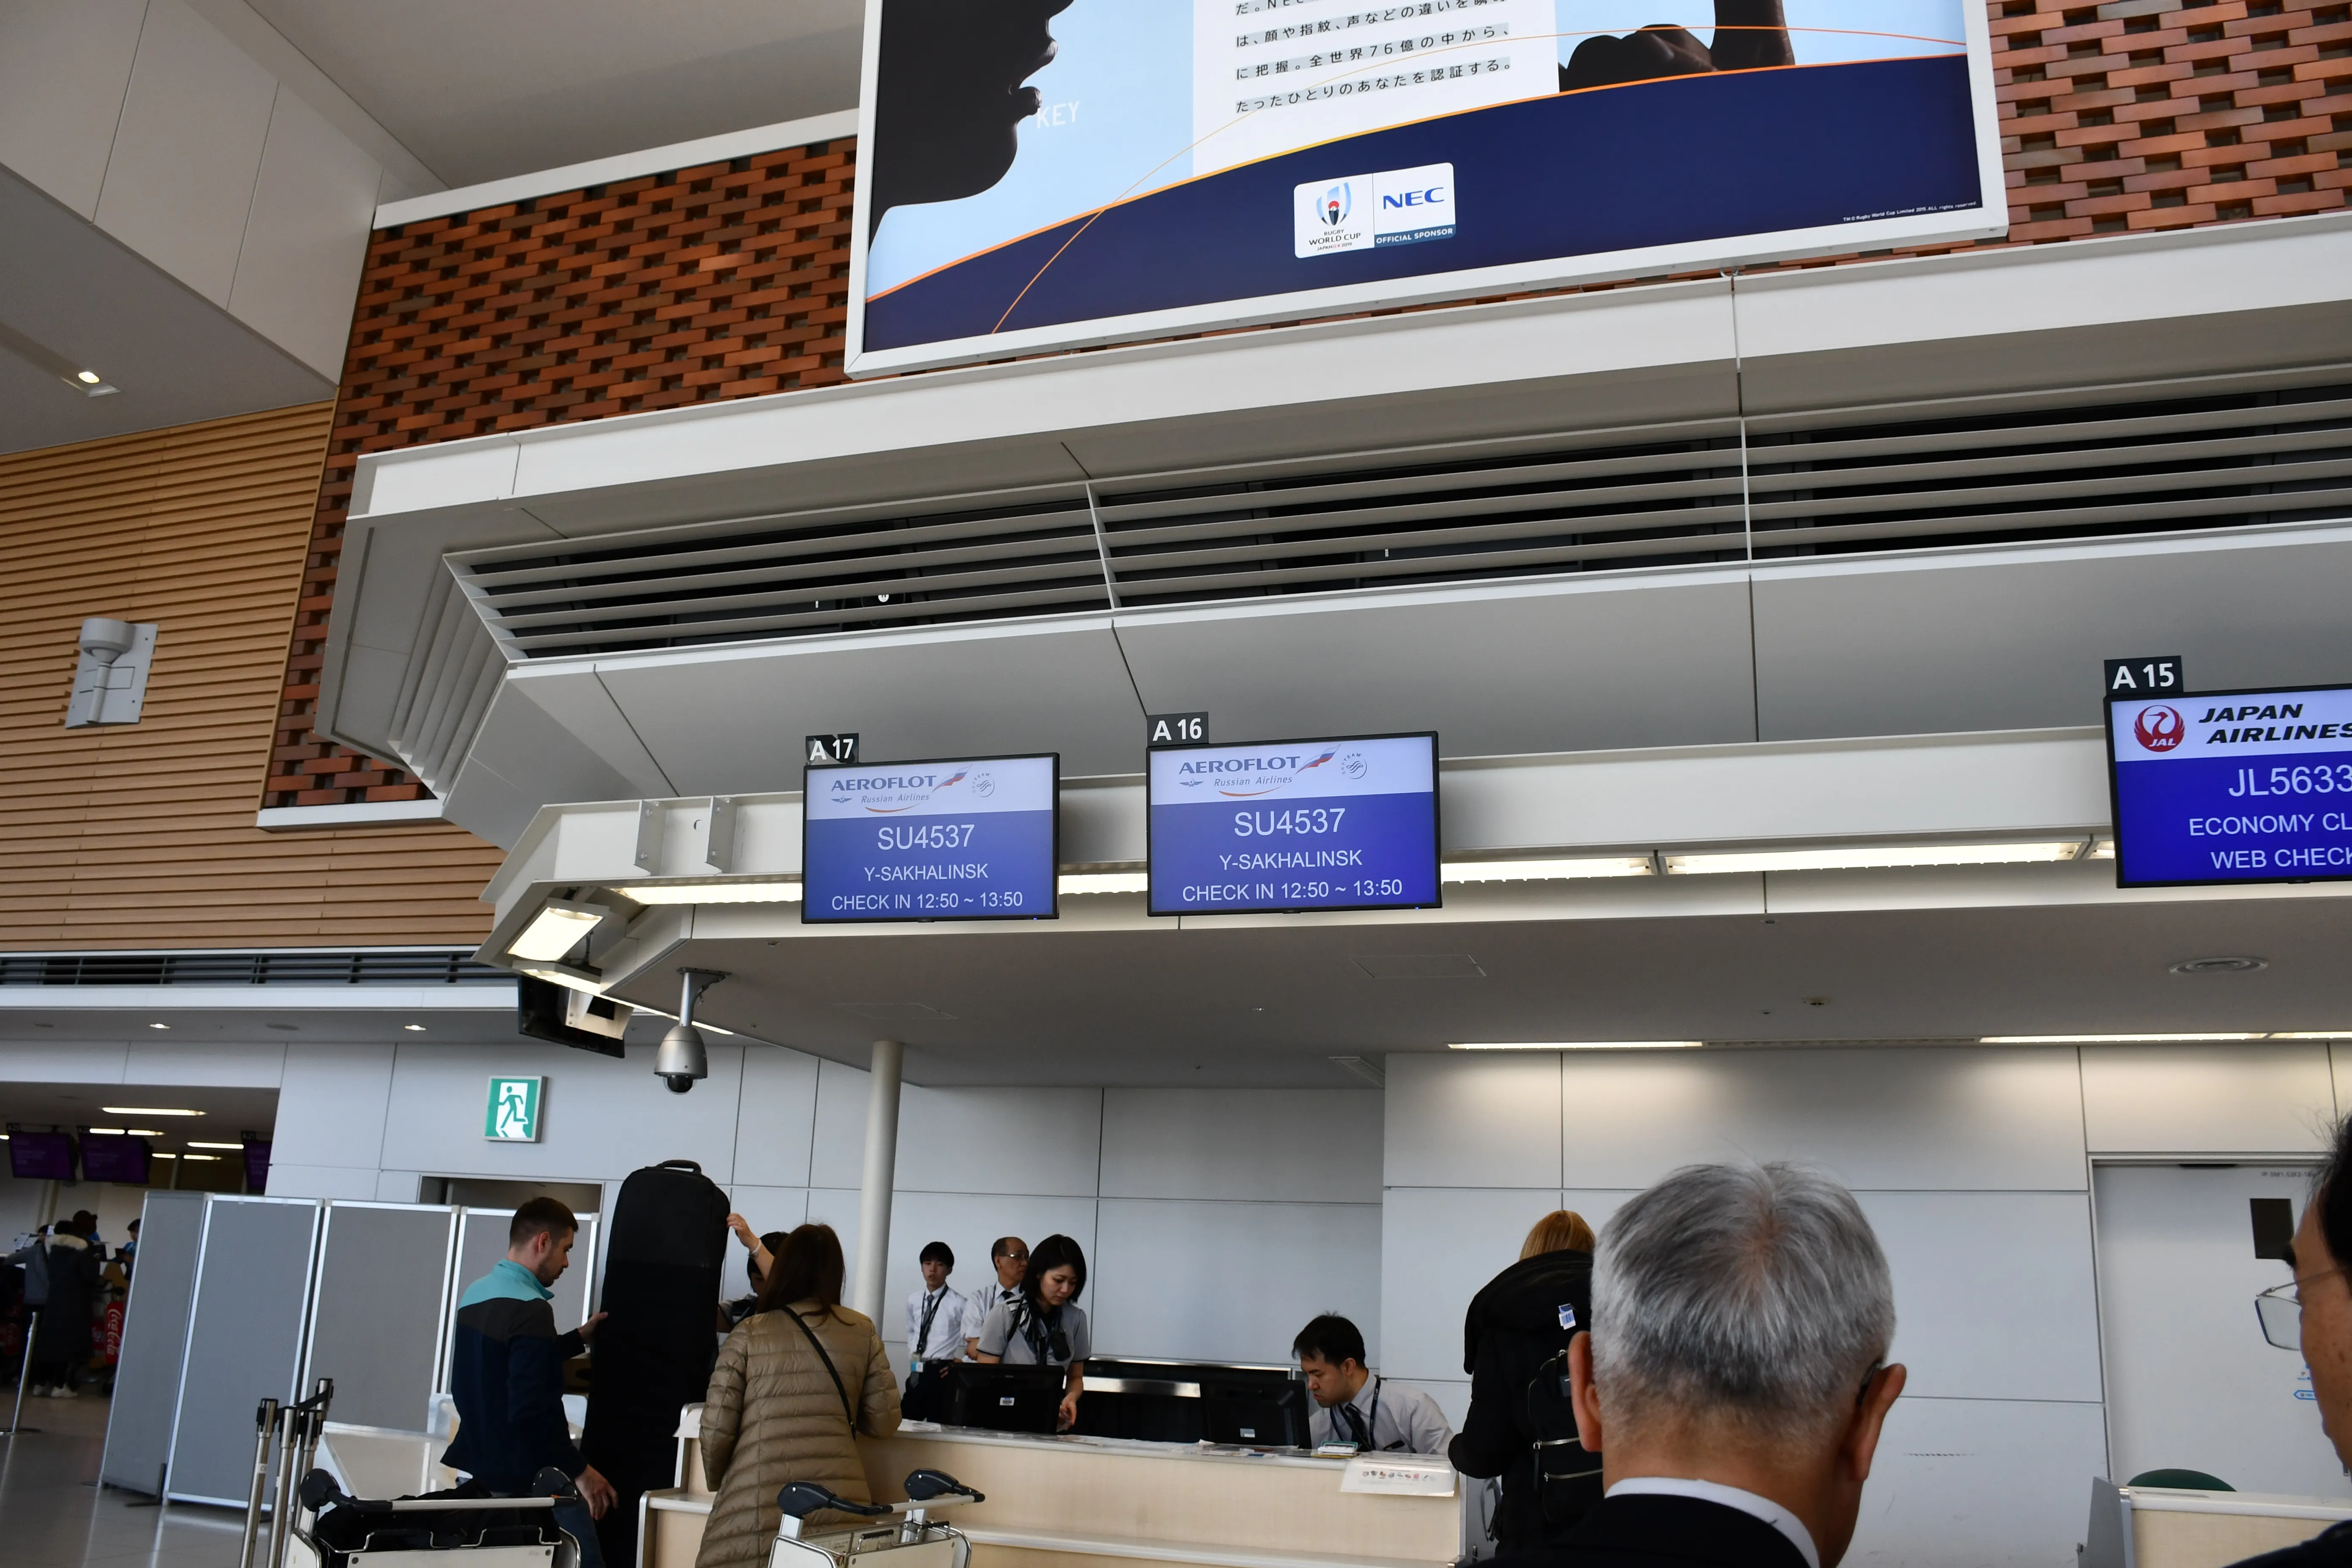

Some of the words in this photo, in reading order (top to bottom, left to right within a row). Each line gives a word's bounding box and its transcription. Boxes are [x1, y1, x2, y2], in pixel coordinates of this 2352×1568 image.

[1236, 26, 1508, 80] に把握。全世界76億の中から、
[1236, 63, 1510, 113] たったひとりのあなたを認証する。
[1037, 101, 1080, 128] KEY
[1383, 187, 1445, 210] NEC
[1309, 235, 1342, 245] WORLD
[1376, 234, 1412, 244] OFFICIAL
[1414, 228, 1453, 240] SPONSOR
[2142, 663, 2174, 688] 15
[2199, 703, 2303, 723] JAPAN
[1177, 718, 1202, 740] 16
[2206, 723, 2352, 744] AIRLINES
[833, 738, 853, 759] 17
[2148, 738, 2176, 747] JAL
[1179, 756, 1300, 775] AEROFLOT
[1341, 753, 1361, 775] SKYTEAM
[831, 775, 937, 792] AEROFLOT
[1214, 778, 1250, 787] Russian
[1255, 776, 1293, 784] Airlines
[2228, 765, 2352, 797] JL5633
[861, 794, 893, 803] Russian
[897, 792, 929, 801] Airlines
[1234, 808, 1345, 836] SU4537
[2189, 814, 2315, 836] ECONOMY
[877, 824, 975, 850] SU4537
[1219, 849, 1363, 870] Y-SAKHALINSK
[2211, 849, 2267, 869] WEB
[864, 863, 988, 882] Y-SAKHALINSK
[832, 895, 889, 910] CHECK
[895, 894, 911, 909] IN
[917, 893, 958, 909] 12:50
[980, 891, 1023, 907] 13:50
[1183, 885, 1249, 901] CHECK
[1256, 884, 1273, 900] IN
[1282, 882, 1329, 898] 12:50
[1353, 879, 1402, 896] 13:50
